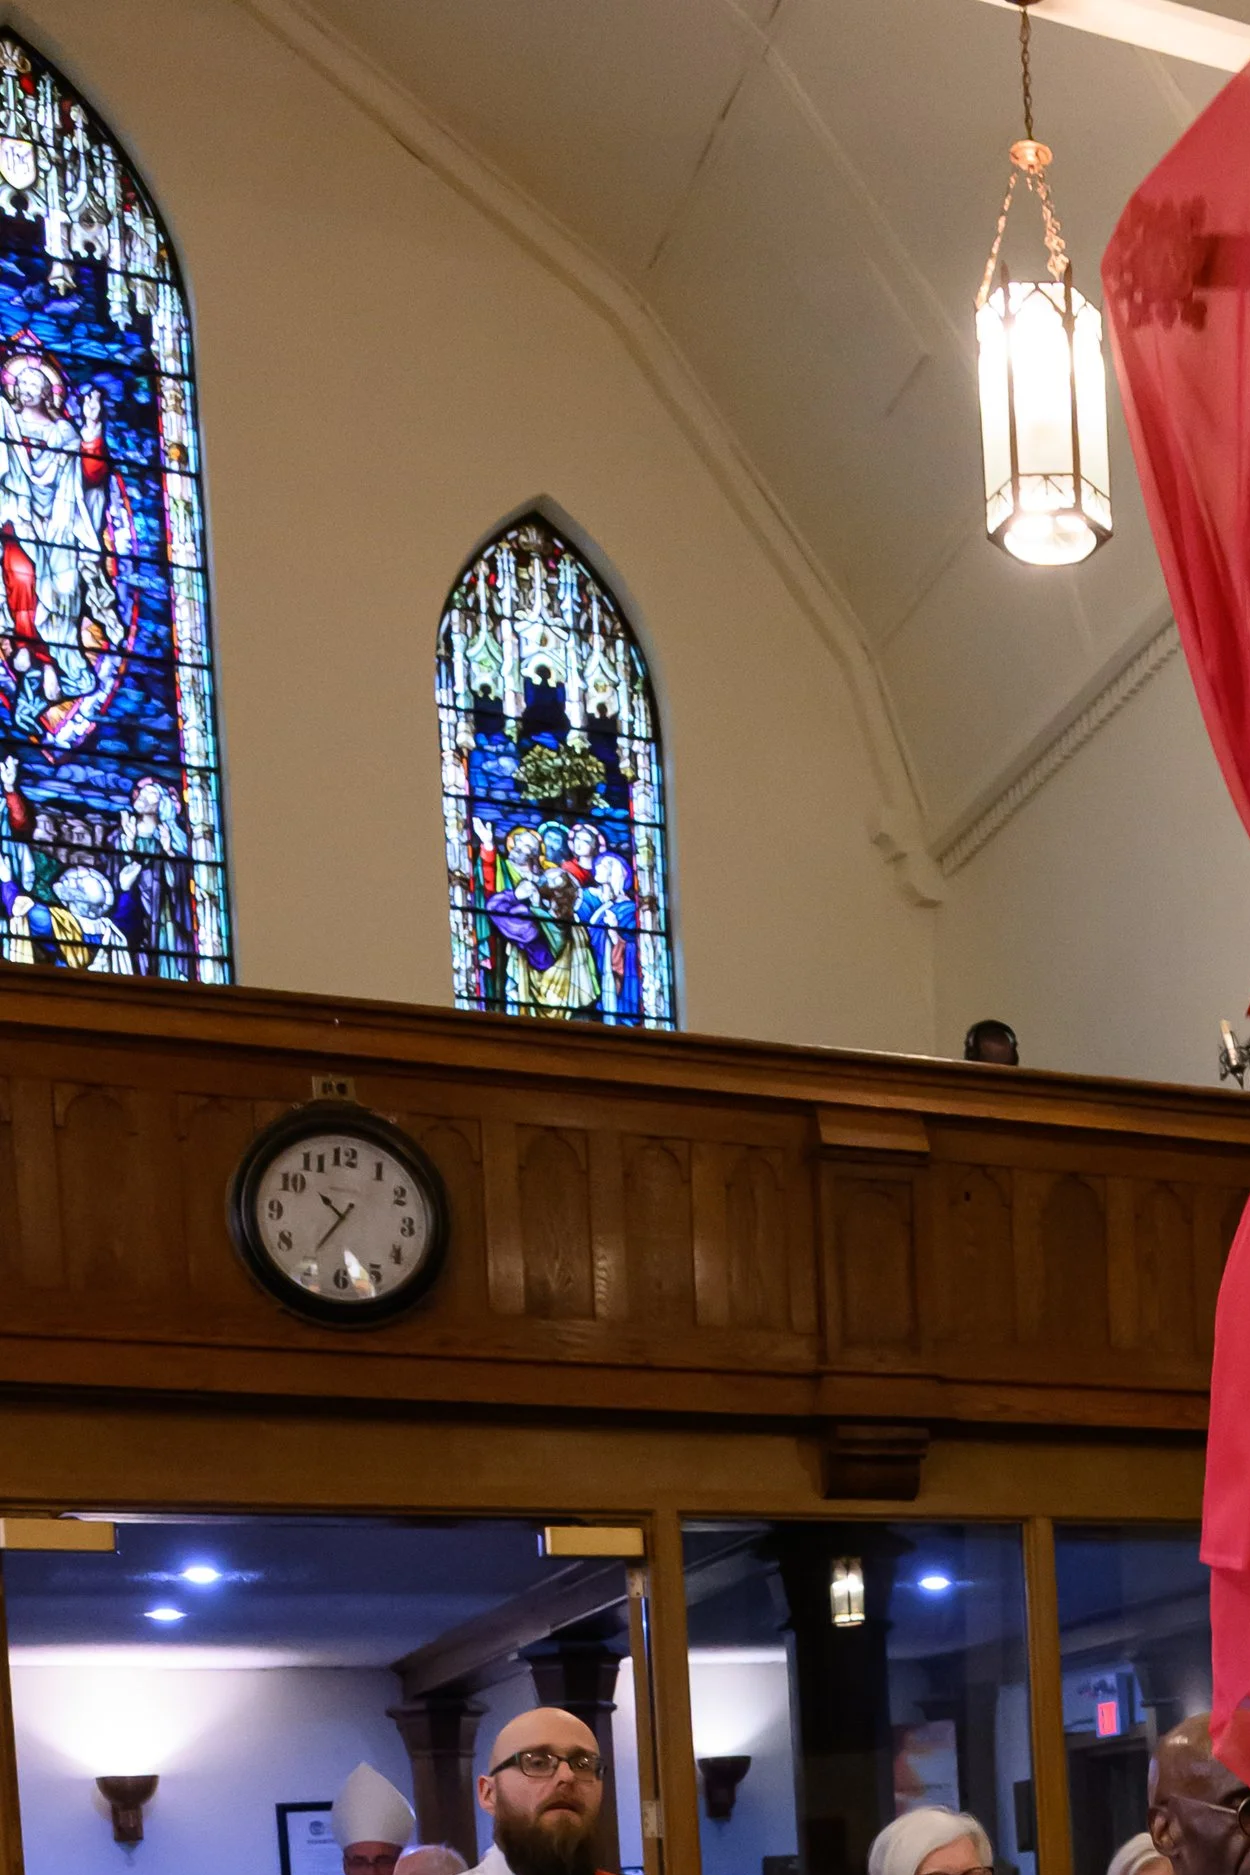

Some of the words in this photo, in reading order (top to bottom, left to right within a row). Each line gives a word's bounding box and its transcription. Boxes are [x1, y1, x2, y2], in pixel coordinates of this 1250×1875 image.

[303, 1151, 326, 1174] 11
[332, 1146, 358, 1169] 12
[373, 1161, 384, 1182] 1
[280, 1172, 307, 1194] 10
[393, 1185, 407, 1207] 2
[268, 1199, 283, 1221] 9
[400, 1216, 416, 1238] 3
[277, 1230, 293, 1251] 8
[391, 1242, 403, 1265] 4
[332, 1267, 350, 1290] 6
[369, 1263, 383, 1285] 5
